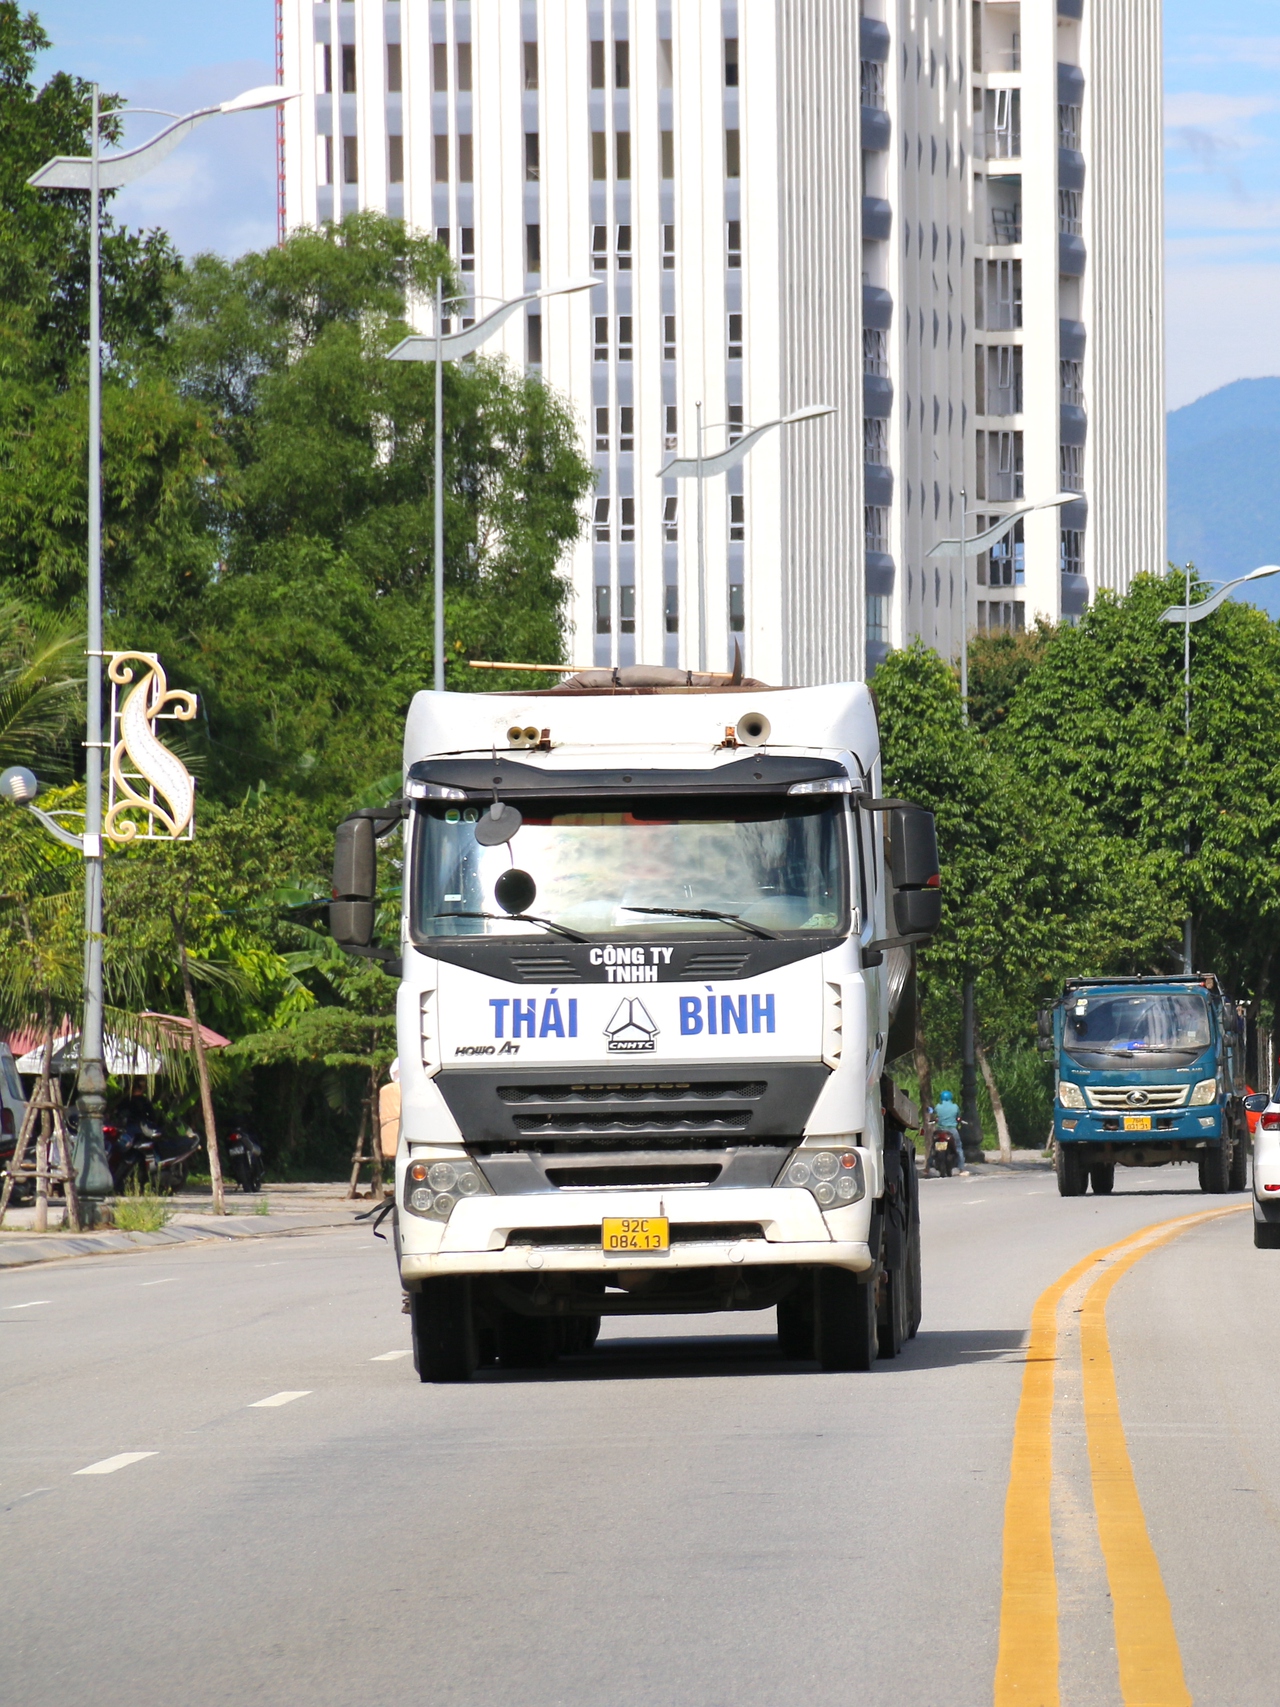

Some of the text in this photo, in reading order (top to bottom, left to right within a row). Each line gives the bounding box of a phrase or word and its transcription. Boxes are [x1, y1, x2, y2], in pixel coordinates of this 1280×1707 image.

[589, 944, 674, 966] CÔNG TY
[605, 965, 658, 983] TNHH
[488, 985, 776, 1038] THÁI BÌNH
[609, 1041, 654, 1049] CNHTC
[621, 1219, 649, 1233] 92C
[609, 1234, 661, 1248] 084.13
